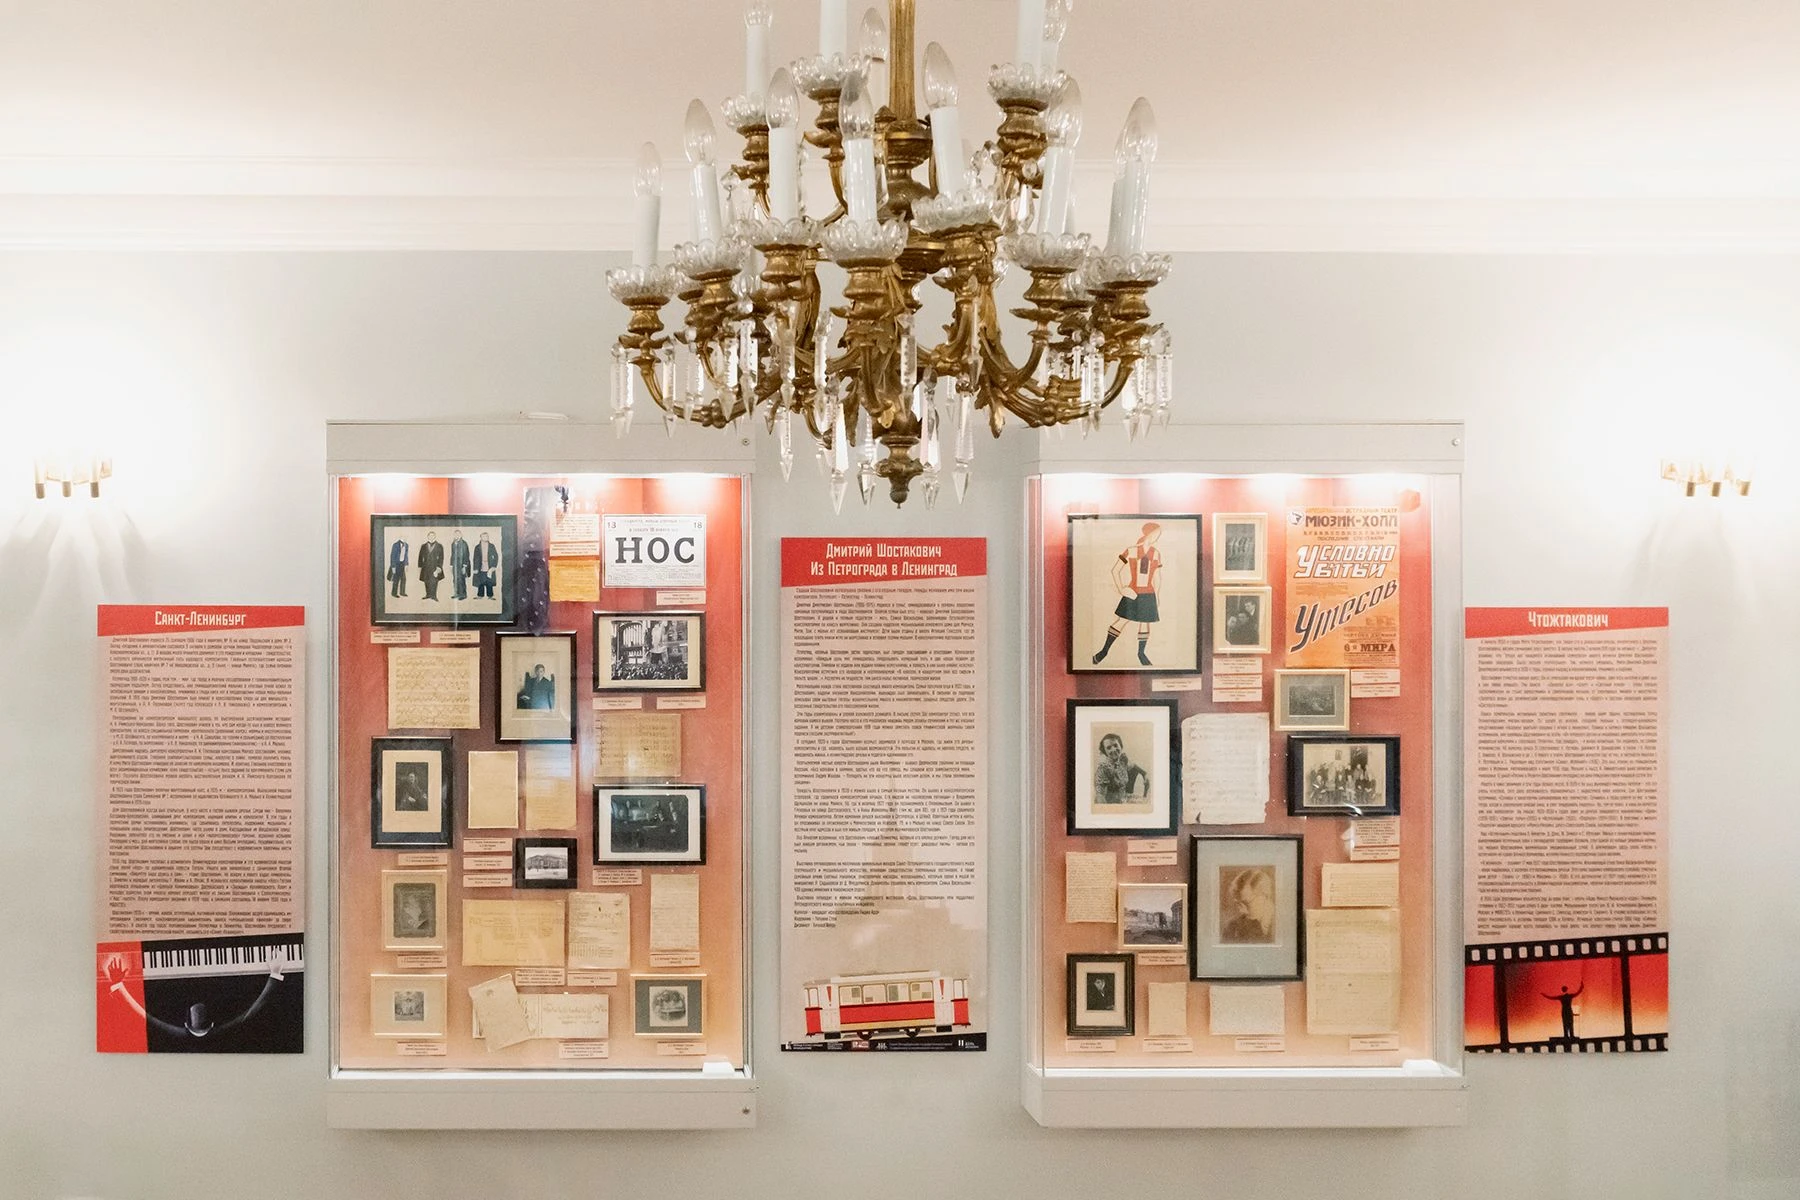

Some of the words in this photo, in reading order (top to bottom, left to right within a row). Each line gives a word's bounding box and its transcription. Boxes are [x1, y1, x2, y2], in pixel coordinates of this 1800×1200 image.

[607, 521, 617, 529] 13
[1304, 515, 1398, 528] МЮЗИК-ХОЛЛ
[615, 537, 695, 564] НОС
[877, 543, 942, 559] Шостакович
[810, 564, 824, 576] Из
[828, 562, 888, 577] Петрограда
[901, 561, 958, 577] Ленинград
[1528, 611, 1609, 627] Чтожтакович
